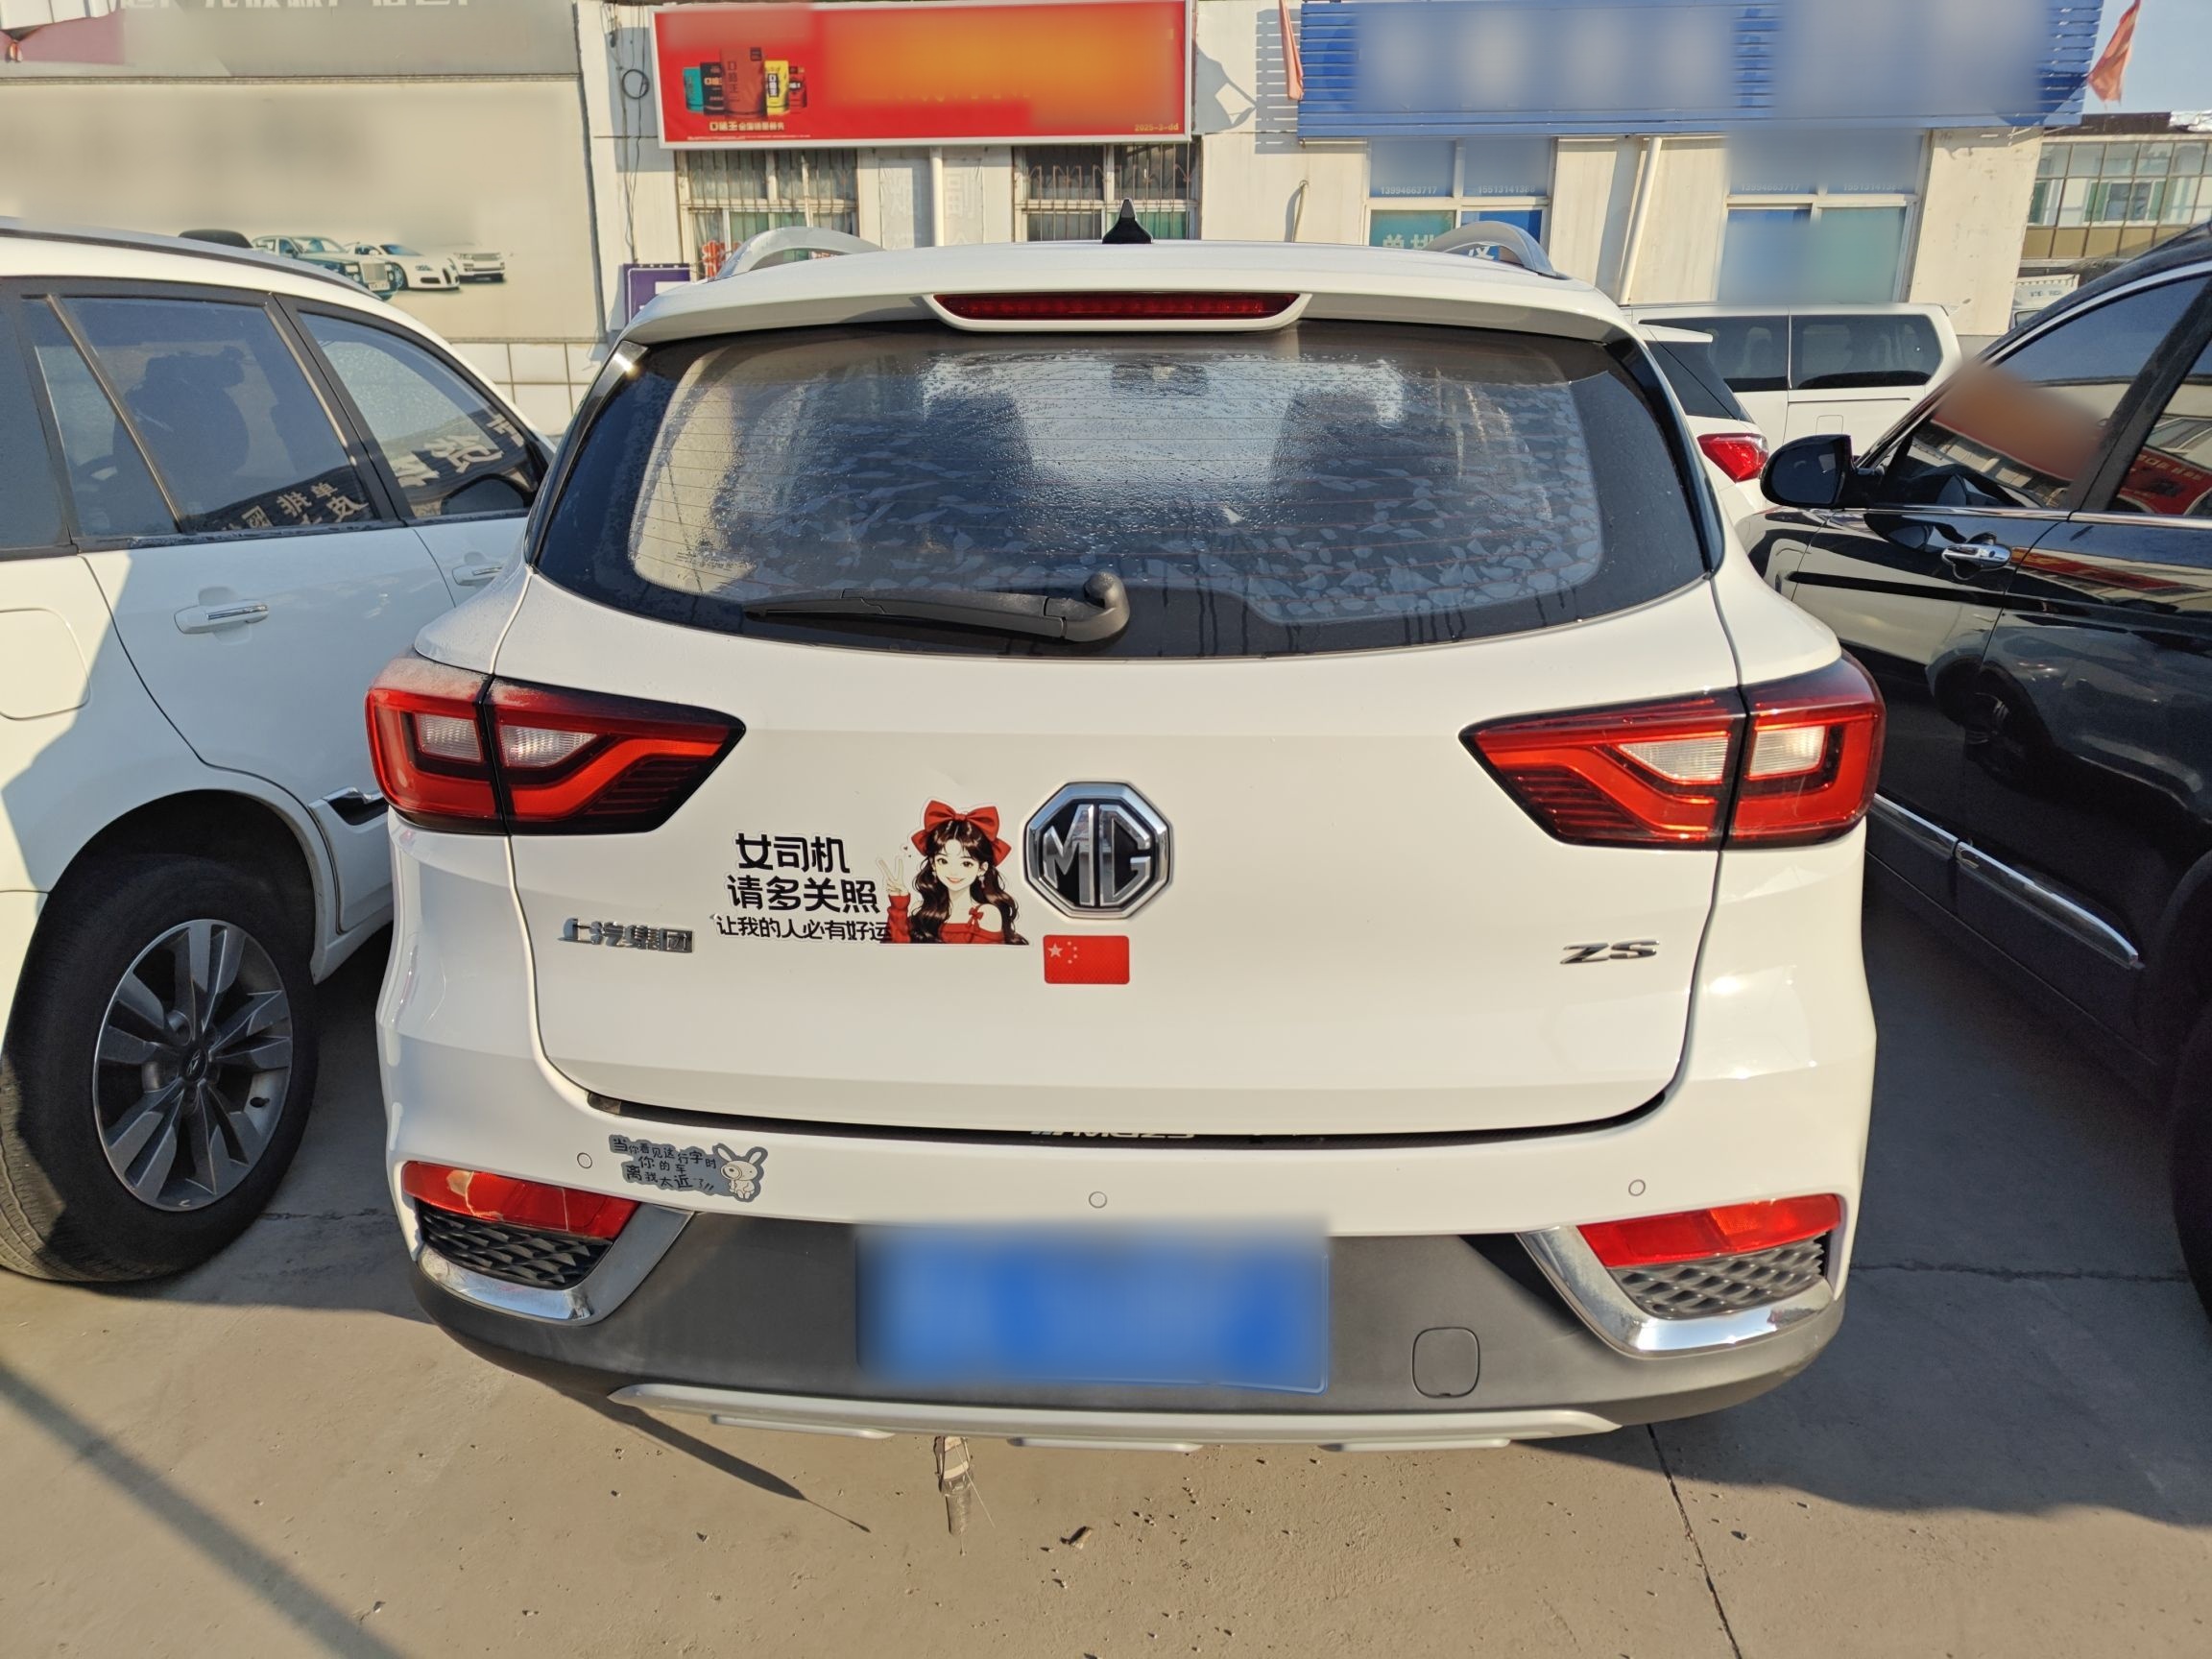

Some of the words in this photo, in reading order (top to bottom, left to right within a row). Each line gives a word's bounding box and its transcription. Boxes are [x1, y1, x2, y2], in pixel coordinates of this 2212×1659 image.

[734, 832, 851, 874] 女司机
[1043, 803, 1152, 907] MG
[727, 875, 880, 913] 请多关照
[559, 918, 693, 953] 上汽集团
[716, 915, 892, 941] 让我的人必有好运
[1560, 939, 1660, 965] ZS
[613, 1138, 717, 1169] 当你看见这行字时
[638, 1155, 686, 1174] 你的车
